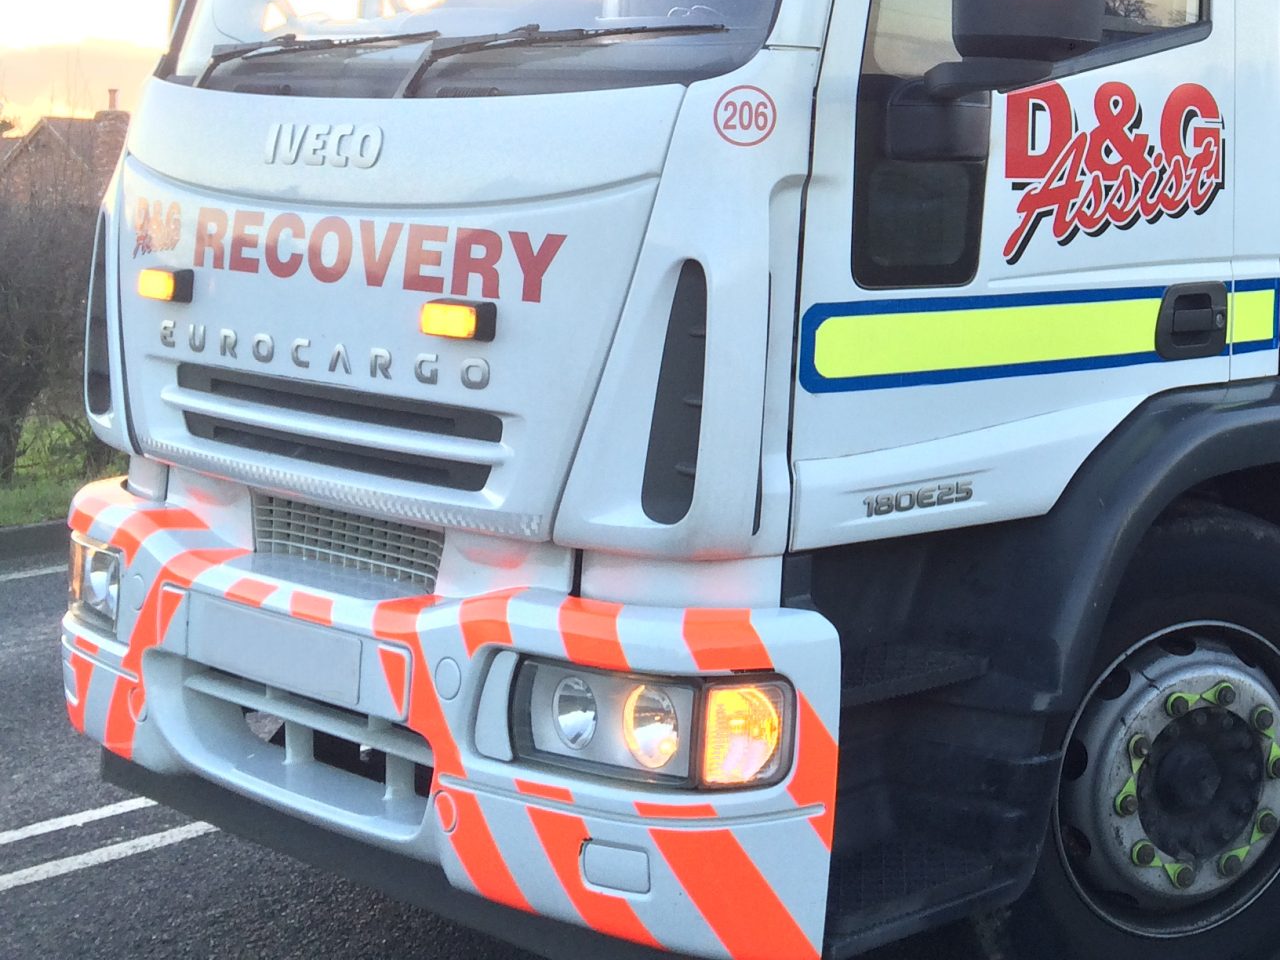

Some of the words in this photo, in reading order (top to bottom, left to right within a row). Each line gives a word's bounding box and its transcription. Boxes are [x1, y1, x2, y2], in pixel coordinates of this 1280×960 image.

[263, 123, 383, 169] IVECO
[722, 100, 769, 132] 206
[1003, 79, 1226, 190] D&G
[1001, 131, 1220, 265] Assist
[193, 207, 567, 303] RECOVERY
[160, 320, 491, 390] EUROCARGO
[863, 481, 973, 517] 180E25
